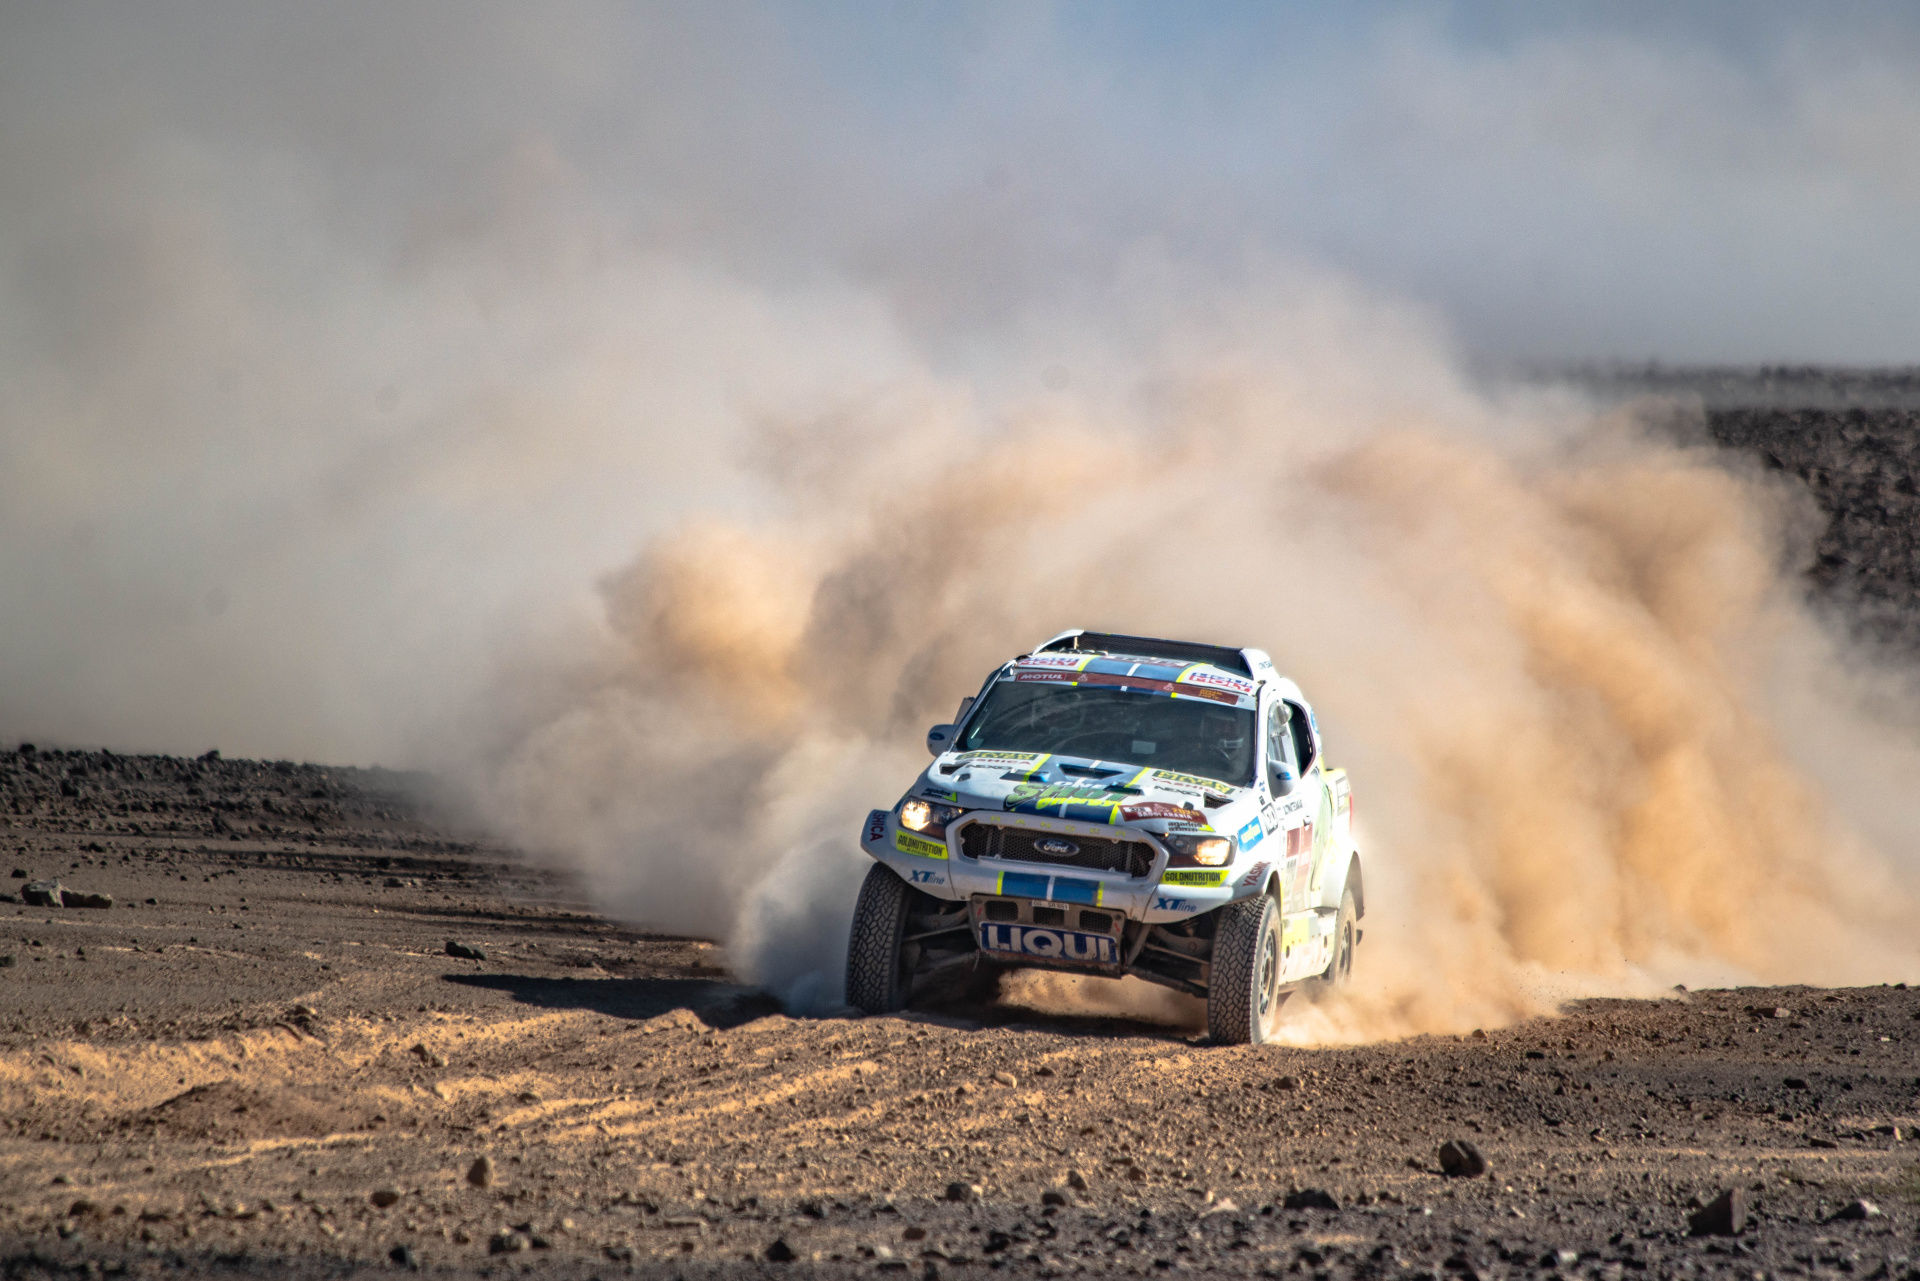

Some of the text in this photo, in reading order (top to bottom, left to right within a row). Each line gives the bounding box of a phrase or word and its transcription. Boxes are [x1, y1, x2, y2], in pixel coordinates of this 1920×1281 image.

[1154, 785, 1201, 797] NEXO
[1164, 811, 1193, 820] ARABIA
[1043, 840, 1069, 853] Ford
[1165, 871, 1221, 882] GOLDNUTRITION
[988, 925, 1110, 963] LIQUI
